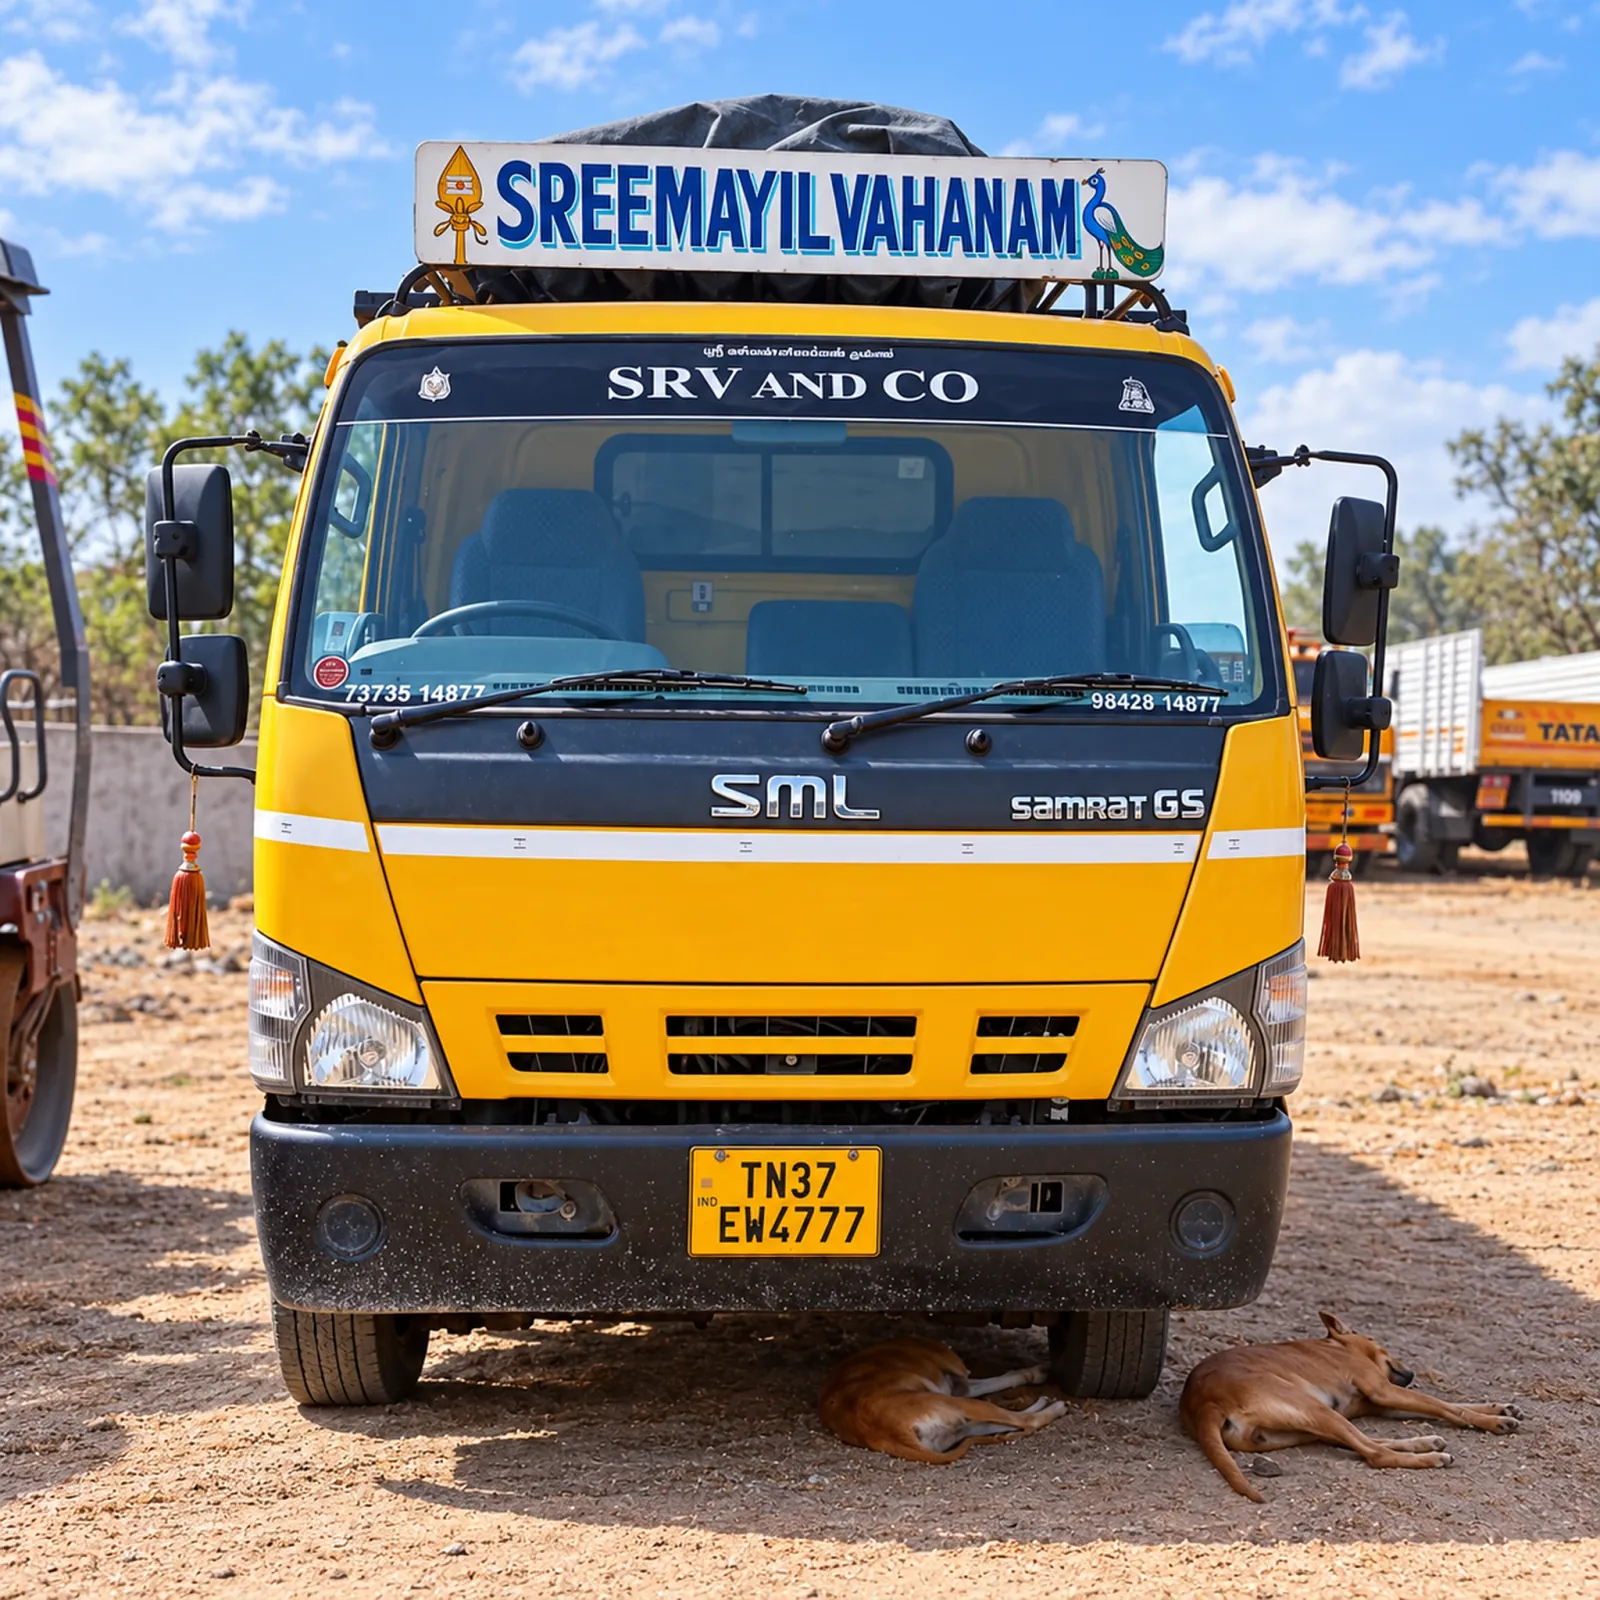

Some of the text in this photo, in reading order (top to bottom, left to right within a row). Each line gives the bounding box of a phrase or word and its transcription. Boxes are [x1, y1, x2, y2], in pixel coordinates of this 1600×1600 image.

[608, 366, 979, 403] SRV AND CO
[345, 685, 486, 702] 73735 14877
[1091, 692, 1221, 713] 98428 14877
[1537, 722, 1600, 742] TATA
[710, 774, 881, 819] SML
[1153, 788, 1206, 820] GS
[741, 1162, 836, 1199] TN37
[697, 1197, 718, 1207] IND
[719, 1206, 865, 1243] EW4777
